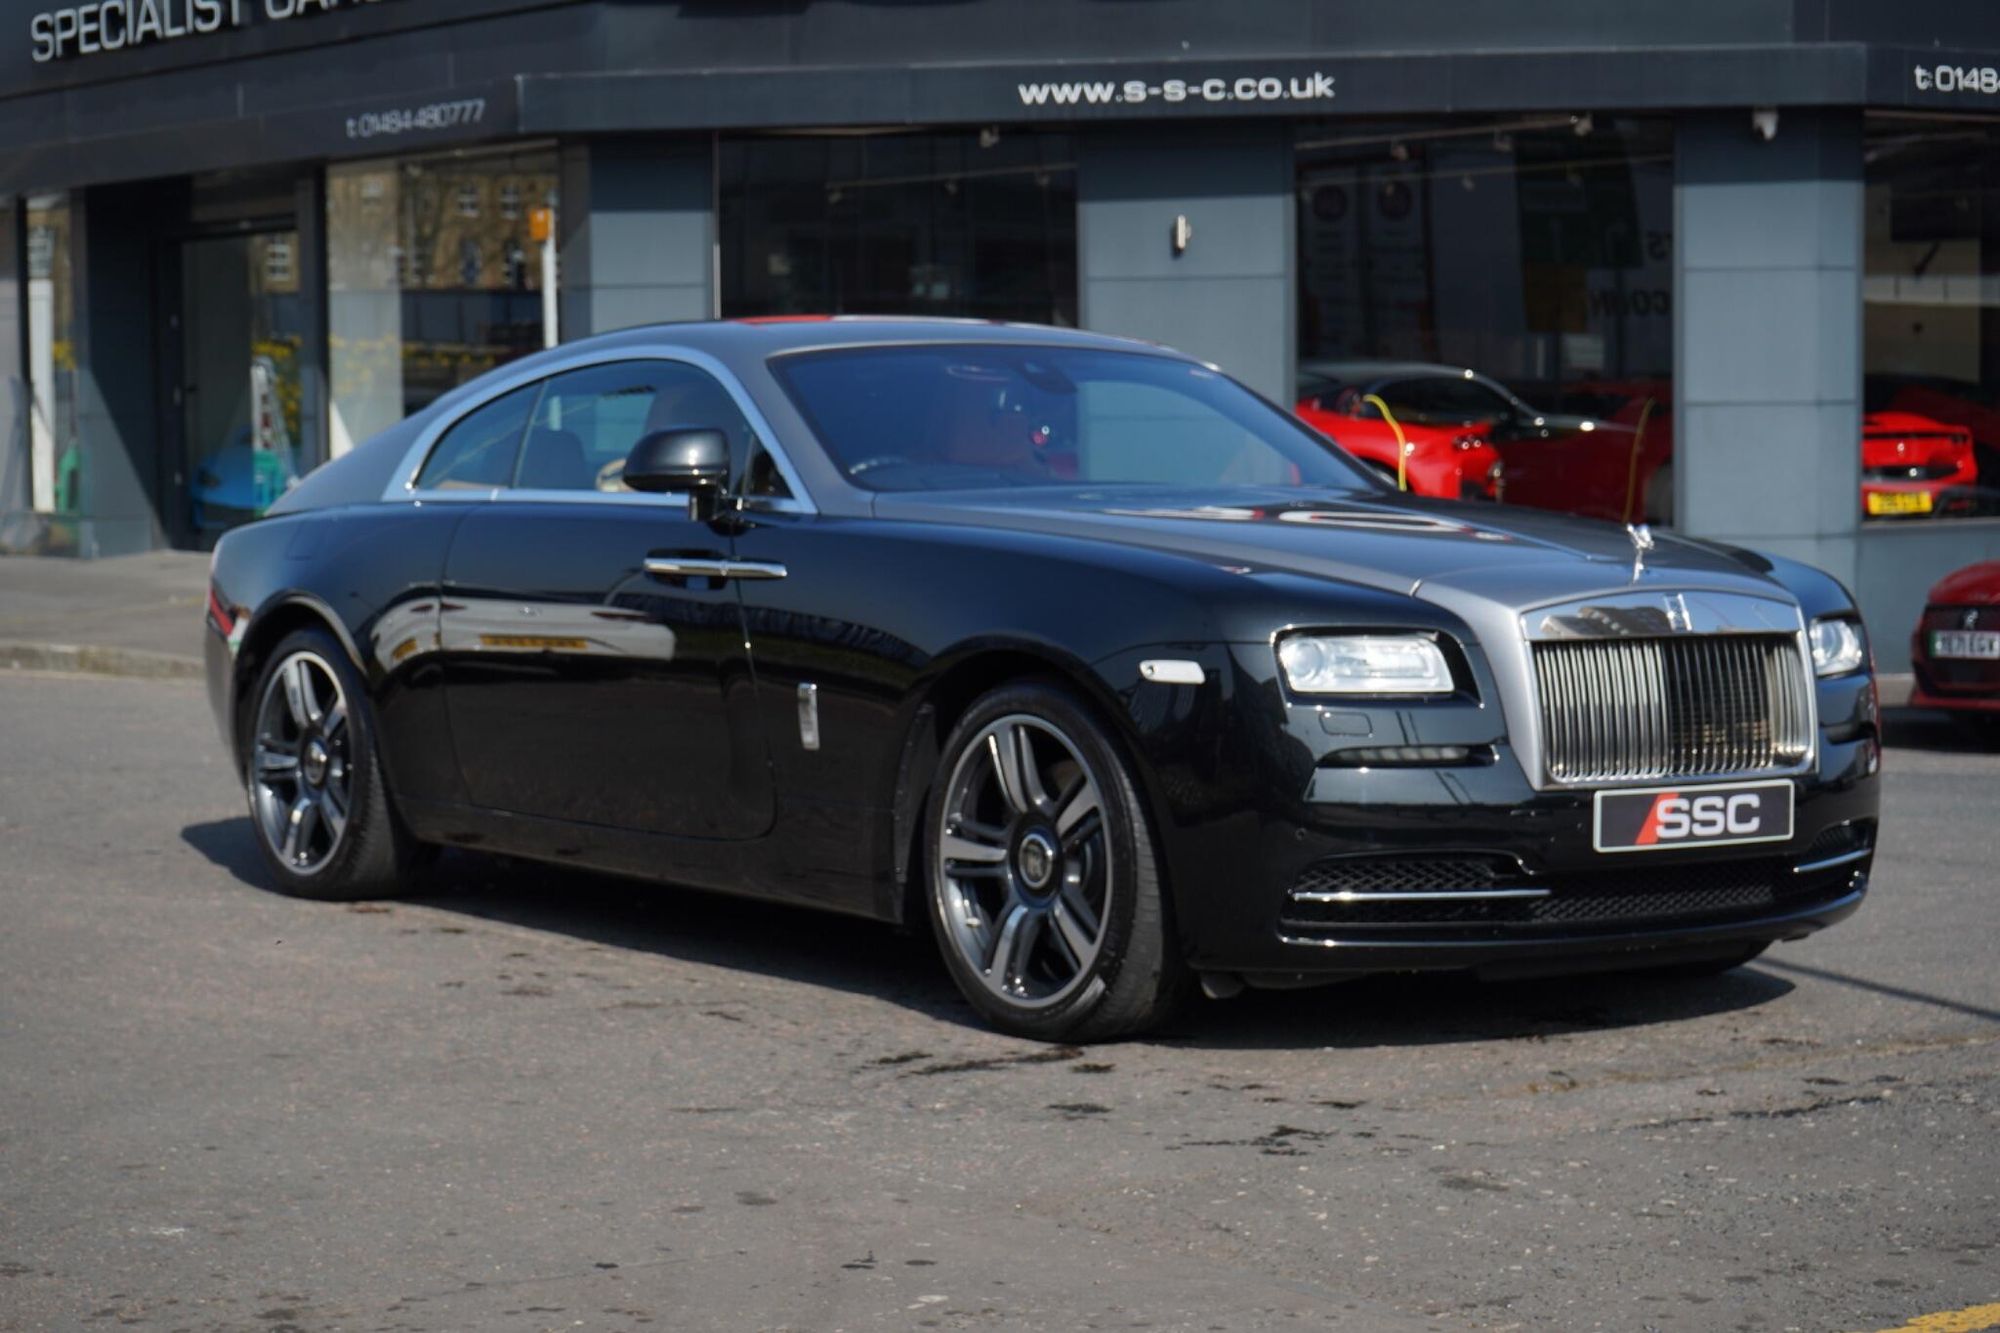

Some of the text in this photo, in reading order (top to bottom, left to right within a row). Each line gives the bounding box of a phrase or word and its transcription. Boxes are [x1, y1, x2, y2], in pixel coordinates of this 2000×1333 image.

[1018, 72, 1335, 105] www.s-s-c.co.uk
[1914, 65, 2000, 93] t:0148
[1655, 794, 1760, 838] SSC
